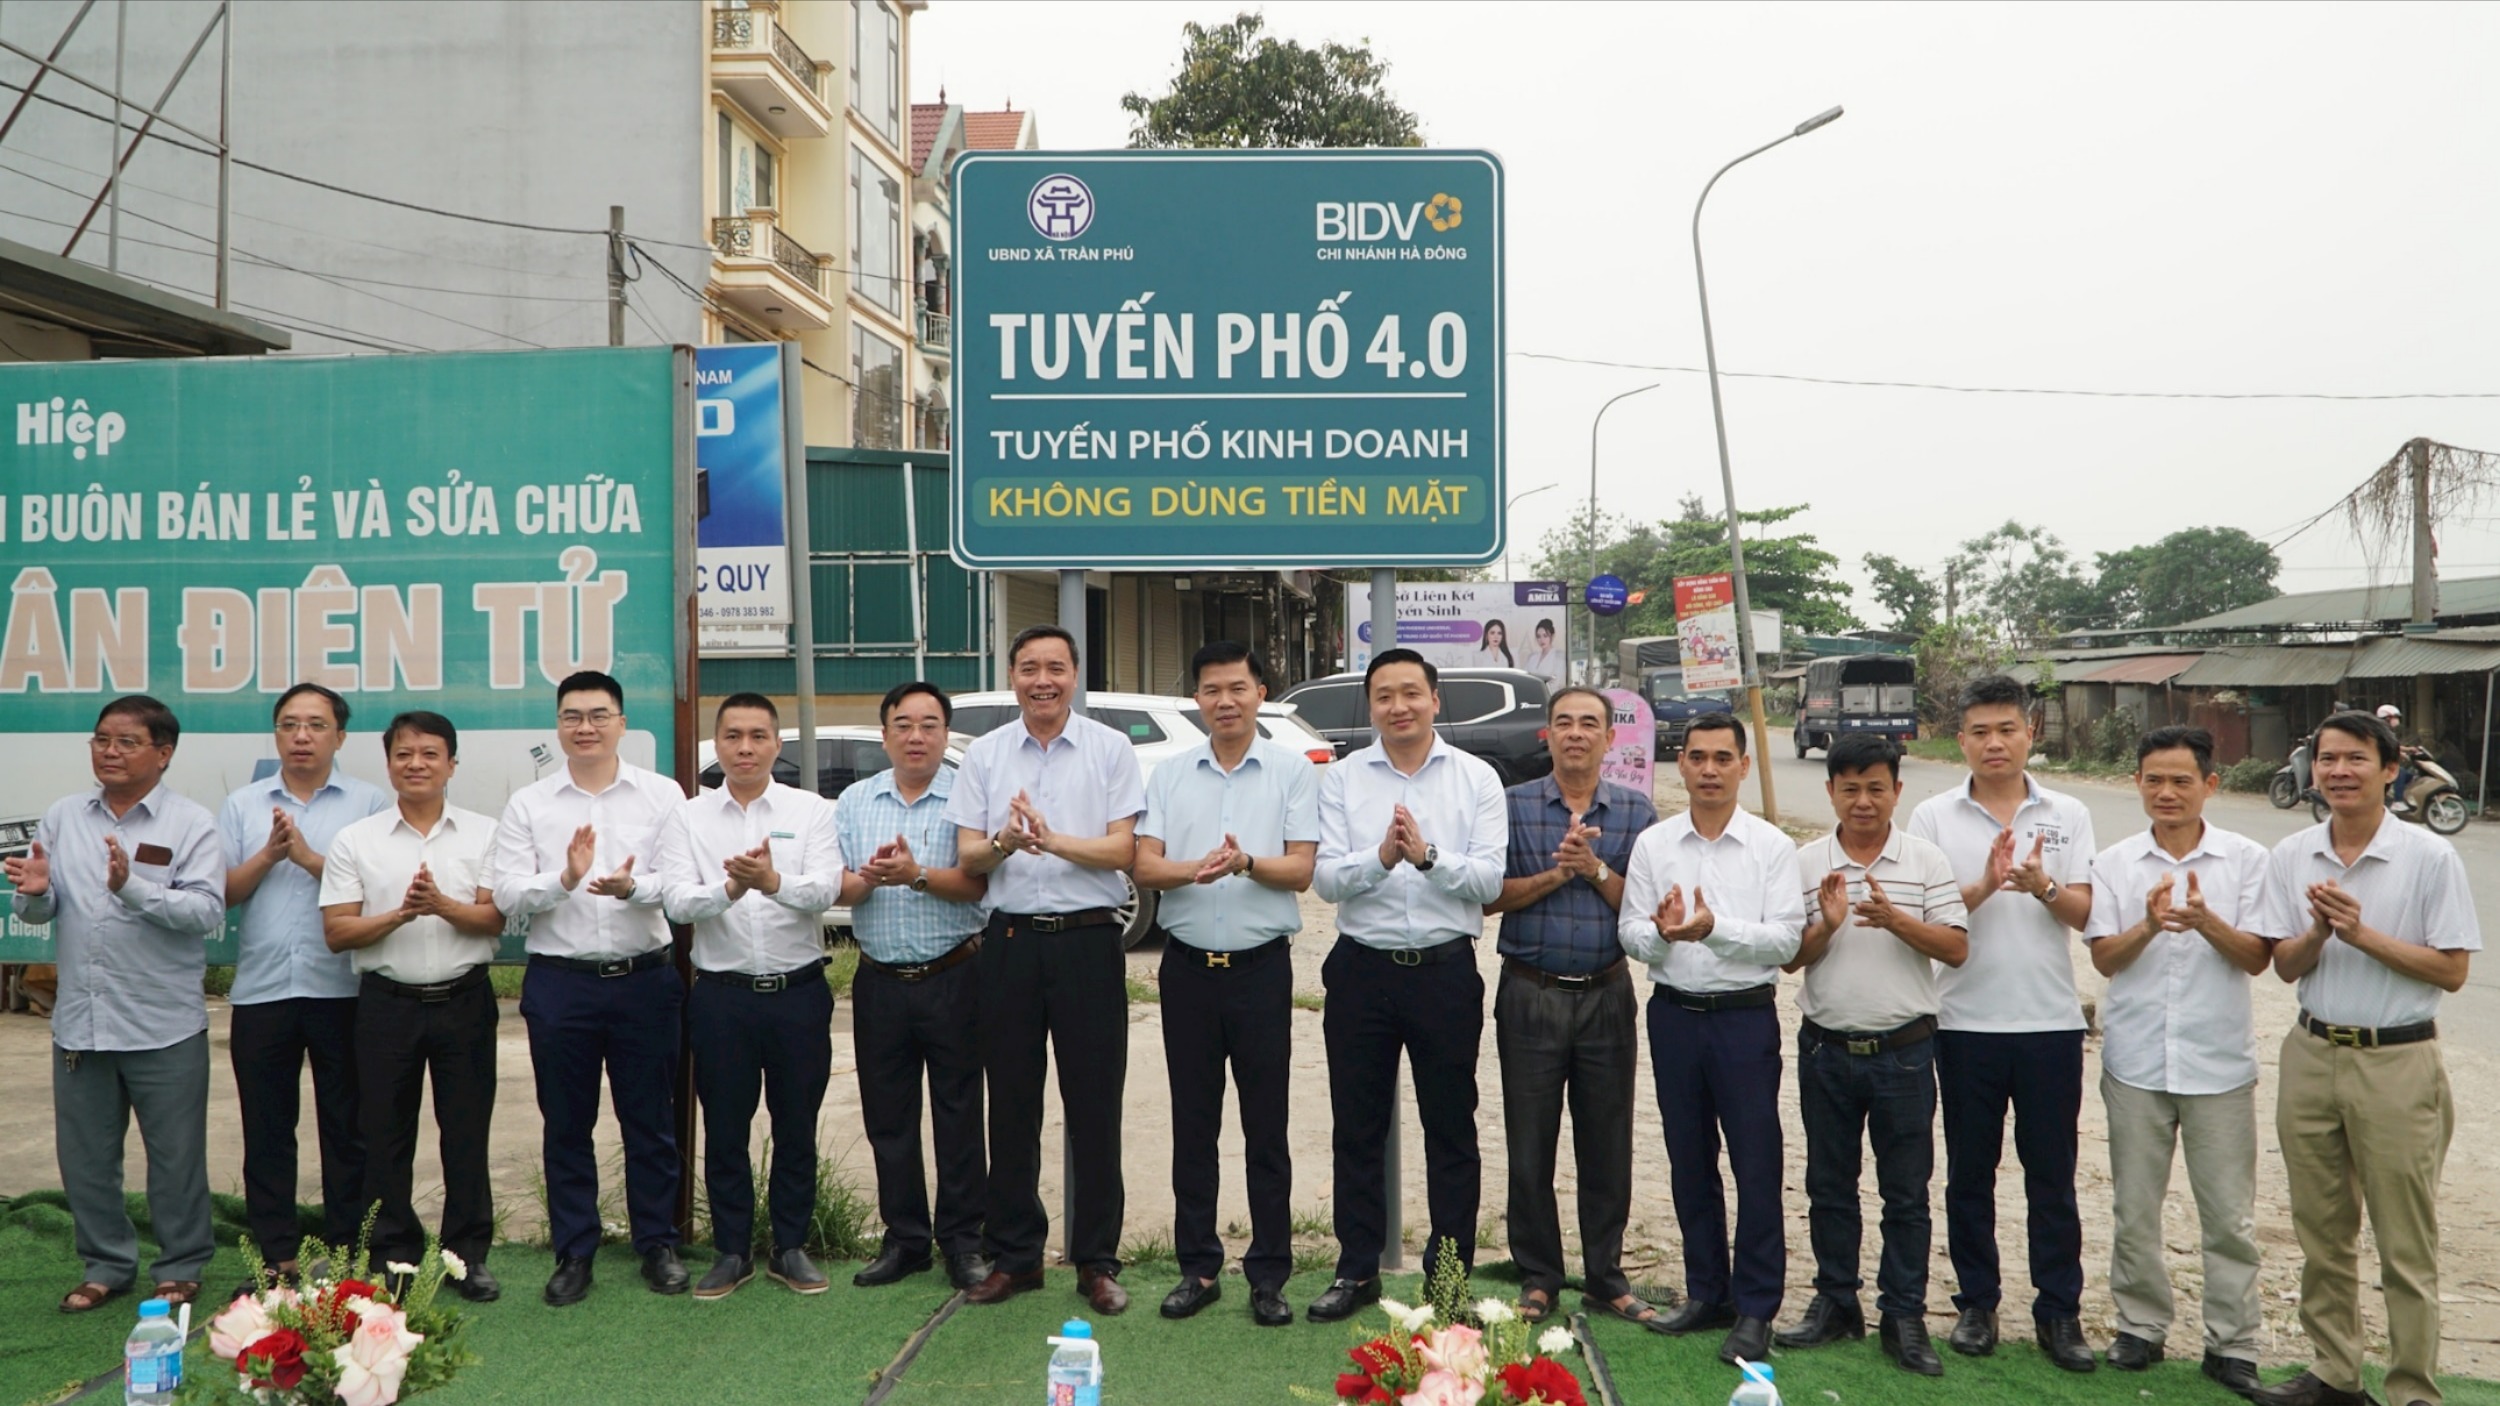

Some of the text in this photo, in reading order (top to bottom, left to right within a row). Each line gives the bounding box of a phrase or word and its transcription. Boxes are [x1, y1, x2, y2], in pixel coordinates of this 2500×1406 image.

[1316, 202, 1425, 241] BIDV
[988, 248, 1031, 261] UBND
[1034, 246, 1055, 261] XÃ
[1103, 245, 1134, 261] PHÚ
[1316, 244, 1468, 260] CHI NHÁNH HÀ ĐÔNG
[989, 290, 1468, 380] TUYẾN PHỐ 4.0
[696, 368, 733, 385] NAM
[16, 396, 126, 460] Hiệp
[990, 420, 1468, 461] TUYẾN PHỐ KINH DOANH
[21, 482, 142, 542] BUÔN
[157, 481, 250, 541] BÁN
[266, 474, 317, 541] LẺ
[331, 478, 392, 540] VÀ
[405, 468, 501, 537] SỬA
[515, 473, 642, 535] CHỮA
[989, 477, 1468, 523] KHÔNG DÙNG TIỀN MẶT
[717, 563, 771, 594] QUY
[1414, 590, 1447, 601] Liên
[1451, 588, 1475, 601] Kết
[1527, 592, 1560, 603] AMIKA
[473, 545, 628, 690] TỬ
[1426, 605, 1461, 616] Sinh
[1614, 713, 1636, 724] IKA
